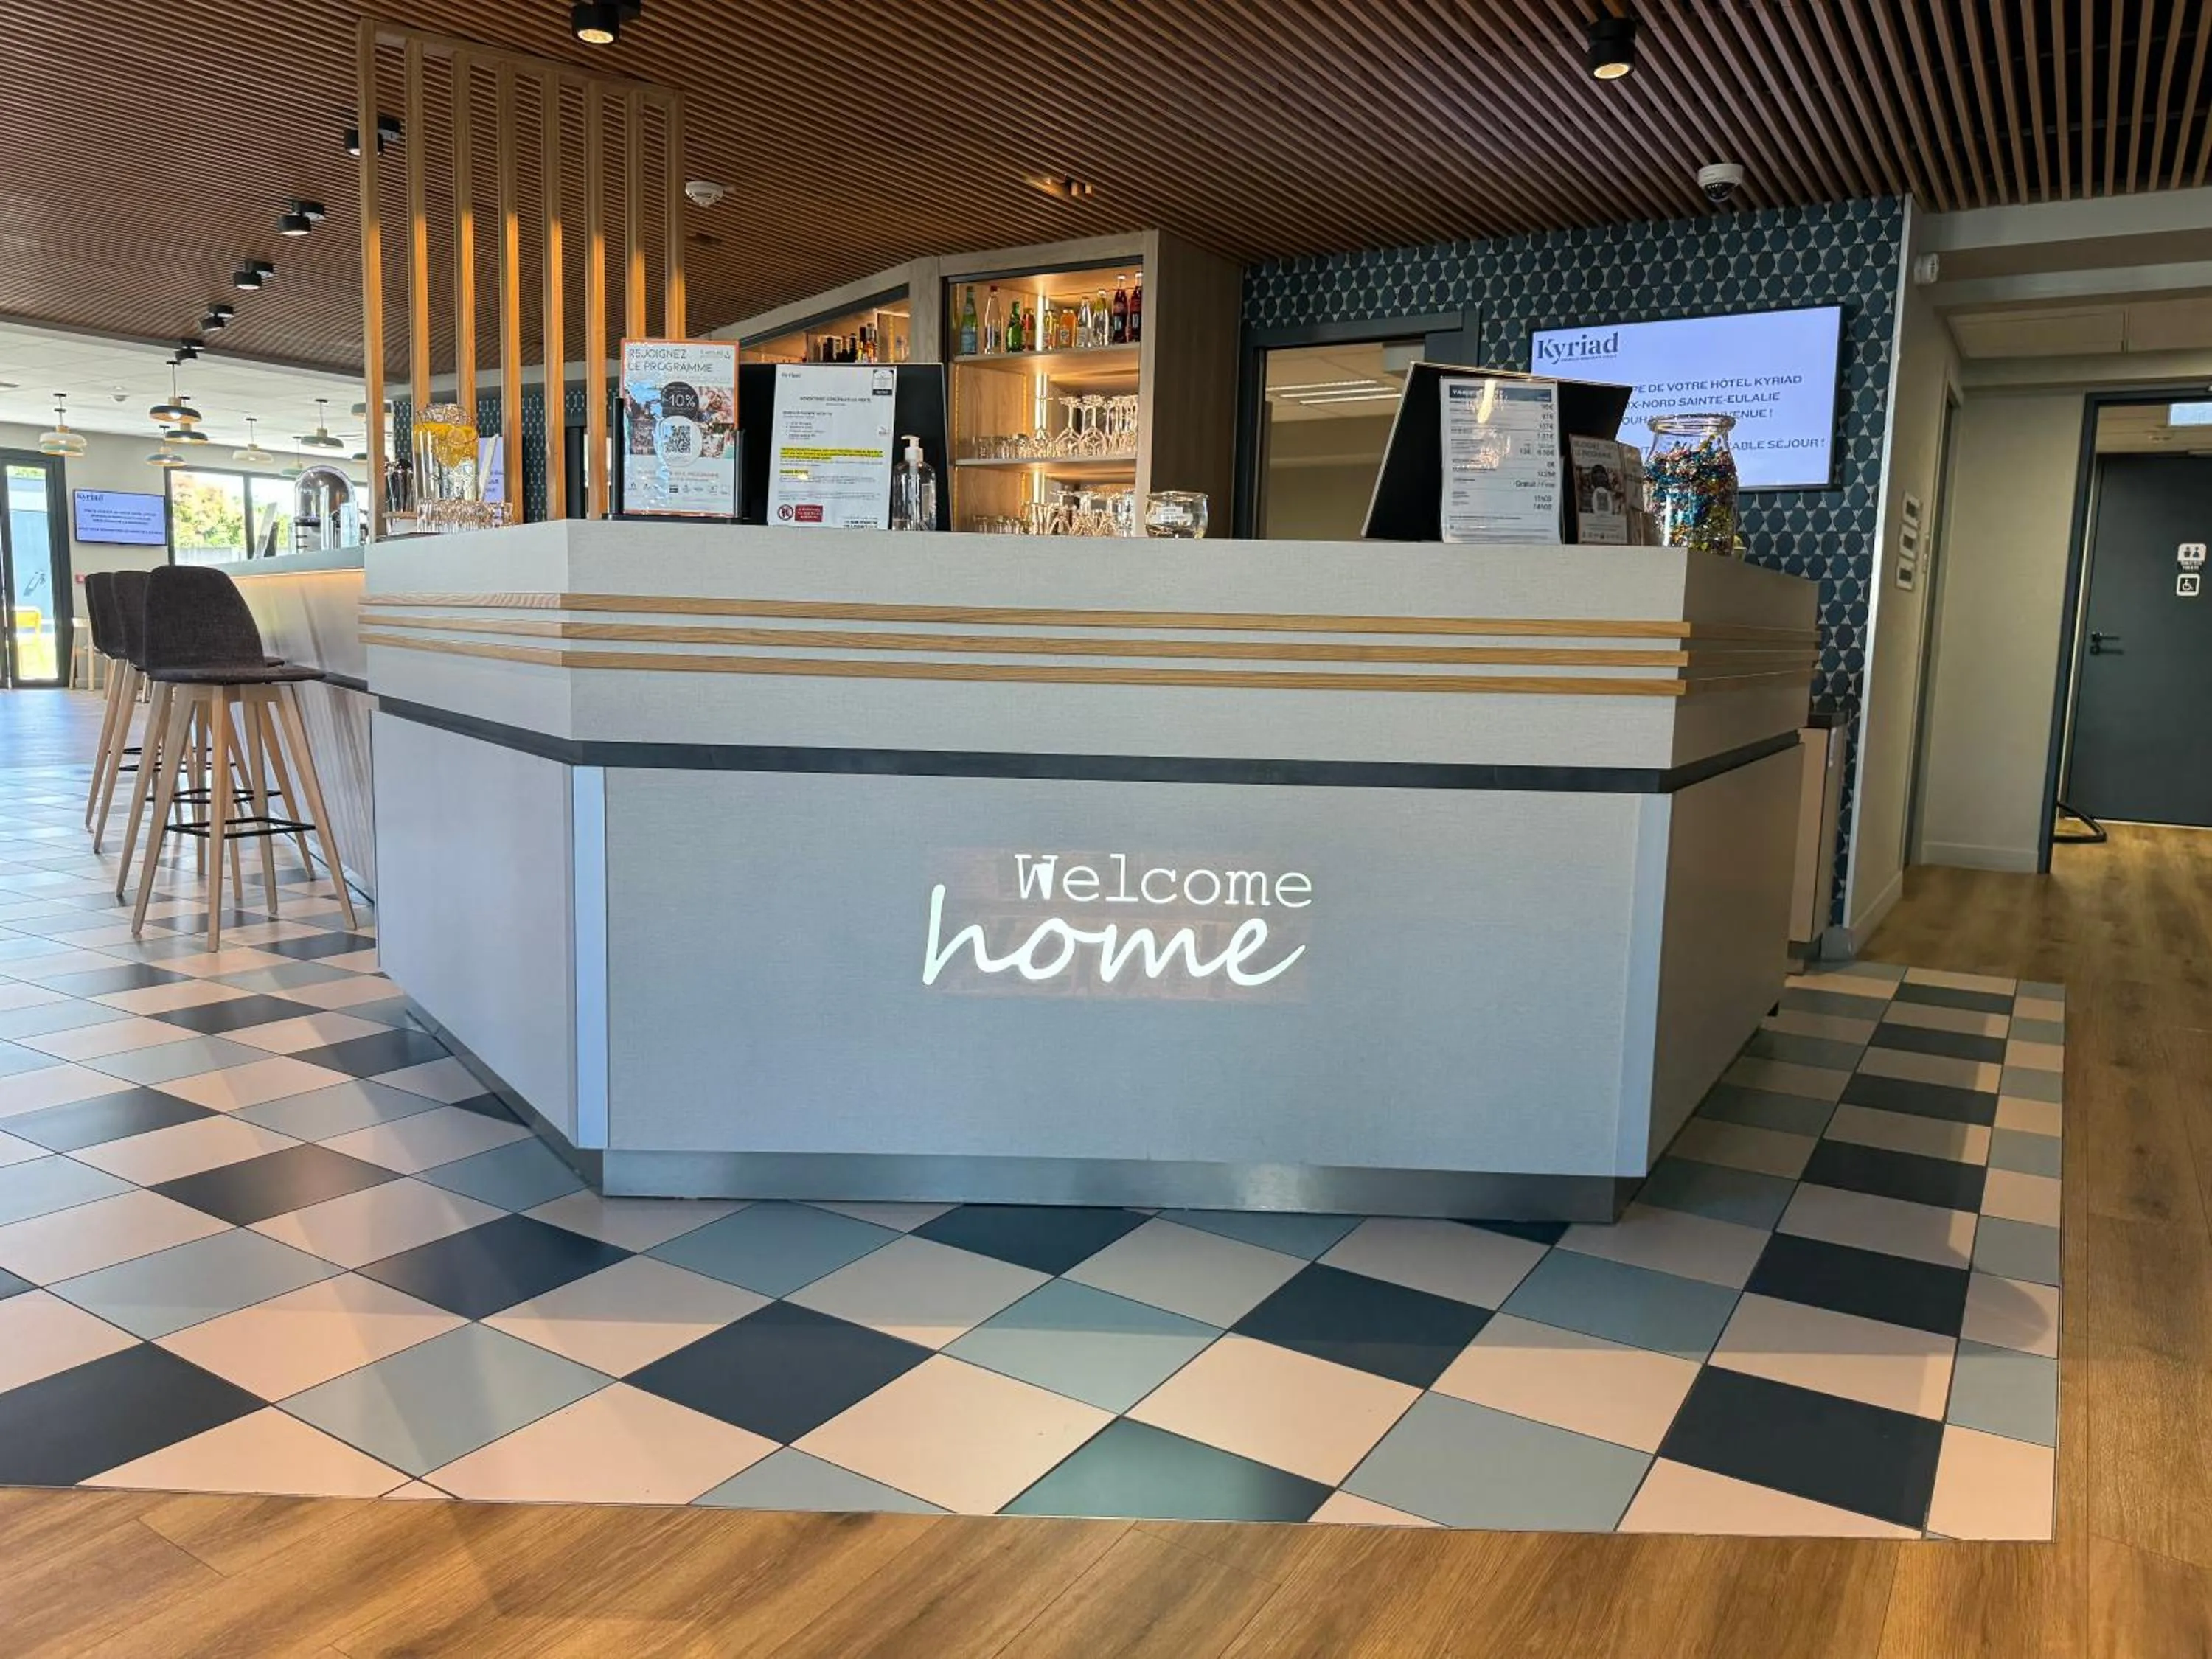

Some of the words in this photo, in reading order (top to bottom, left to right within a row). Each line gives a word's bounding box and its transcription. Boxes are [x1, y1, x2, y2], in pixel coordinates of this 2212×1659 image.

[1537, 332, 1618, 364] Kyriad
[644, 362, 713, 372] PROGRAMME
[1648, 383, 1664, 393] DE
[1667, 380, 1708, 392] VOTRE
[1710, 377, 1752, 389] HÔTEL
[1754, 375, 1803, 386] KYRIAD
[1679, 392, 1781, 406] SAINTE-EULALIE
[1767, 438, 1818, 449] SÉJOUR
[1014, 853, 1312, 908] Welcome
[922, 884, 1306, 987] home
